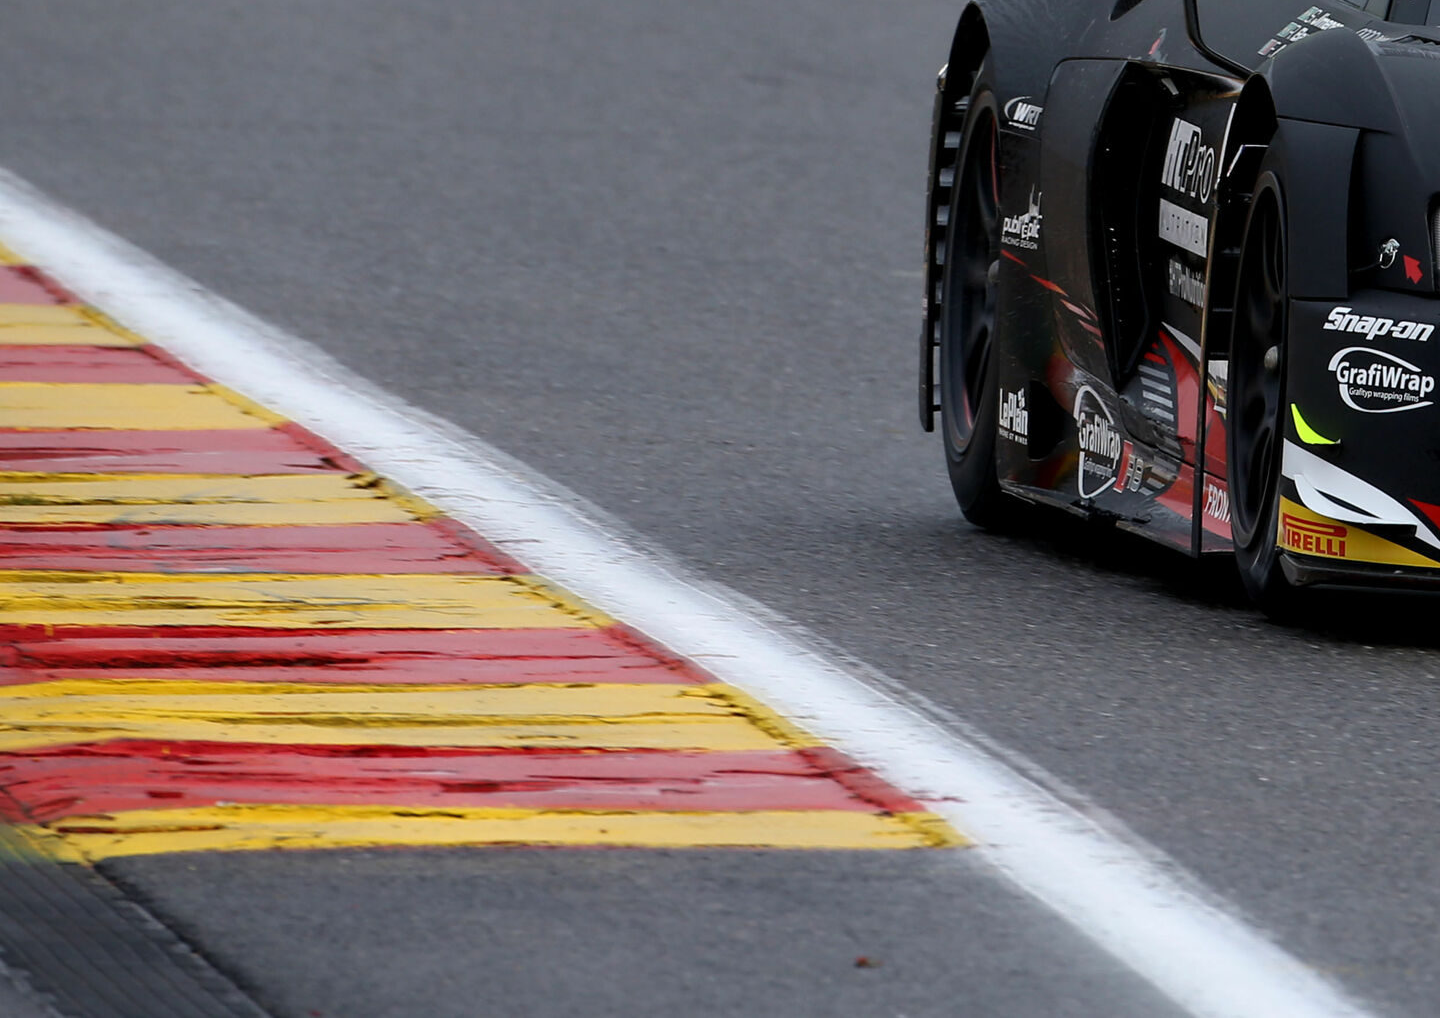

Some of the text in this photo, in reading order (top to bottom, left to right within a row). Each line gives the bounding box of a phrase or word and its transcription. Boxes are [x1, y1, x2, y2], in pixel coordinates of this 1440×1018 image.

[1013, 102, 1044, 126] WRT
[1323, 306, 1435, 342] Snap-on
[1336, 361, 1435, 398] GrafiWrap
[1079, 412, 1120, 469] GrafiWrap
[1280, 512, 1347, 557] PIRELLI
